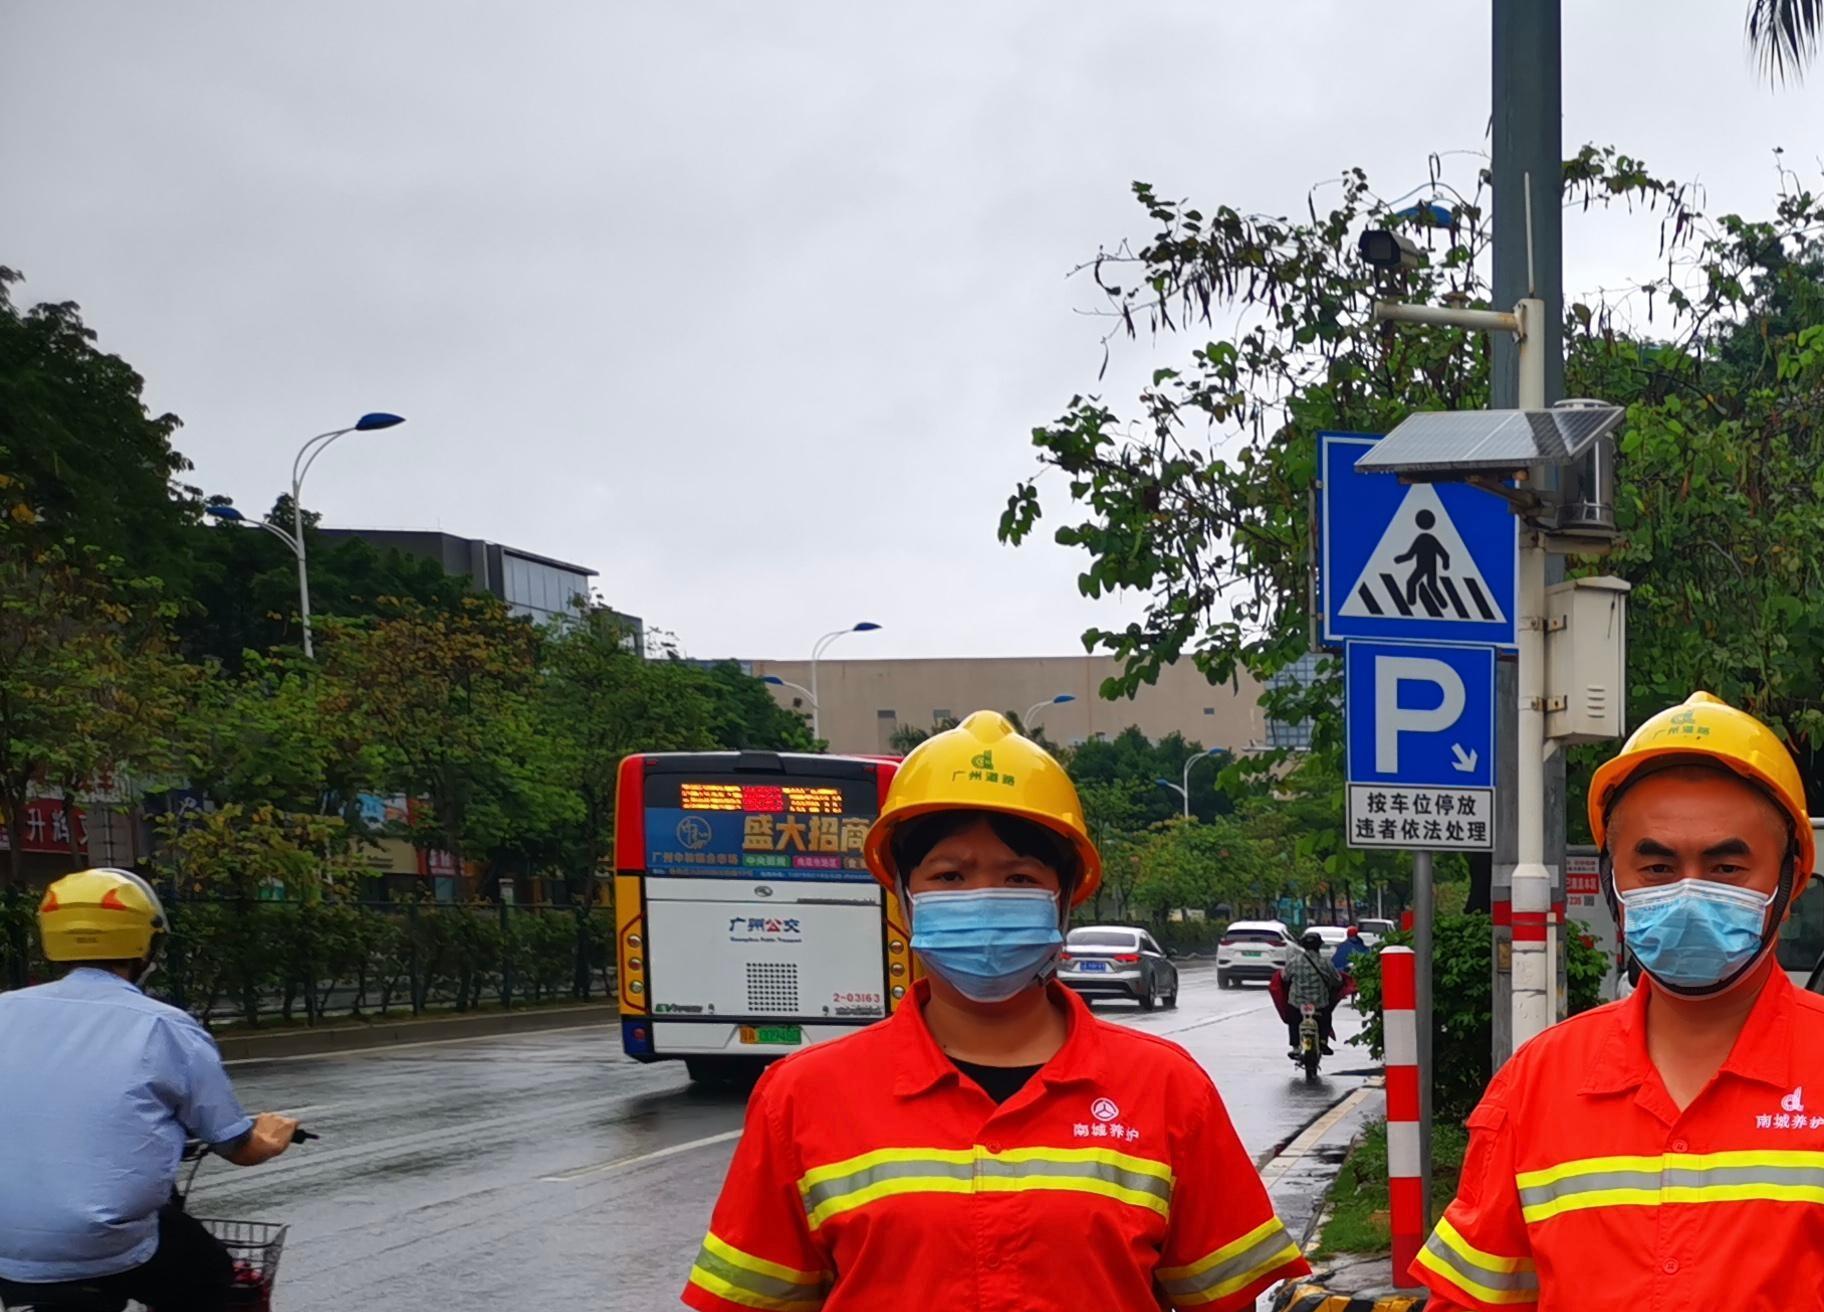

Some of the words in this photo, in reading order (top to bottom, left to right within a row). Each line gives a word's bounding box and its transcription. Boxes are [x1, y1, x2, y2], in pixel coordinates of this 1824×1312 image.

[1375, 655, 1466, 774] P
[952, 770, 1015, 787] 广州道路
[1367, 791, 1477, 817] 按车位停放
[742, 814, 870, 852] 盛大招商
[1356, 817, 1487, 843] 违者依法处理
[729, 916, 801, 933] 广州公交
[833, 992, 880, 1003] 2-03163
[1072, 1123, 1140, 1142] 南城养护
